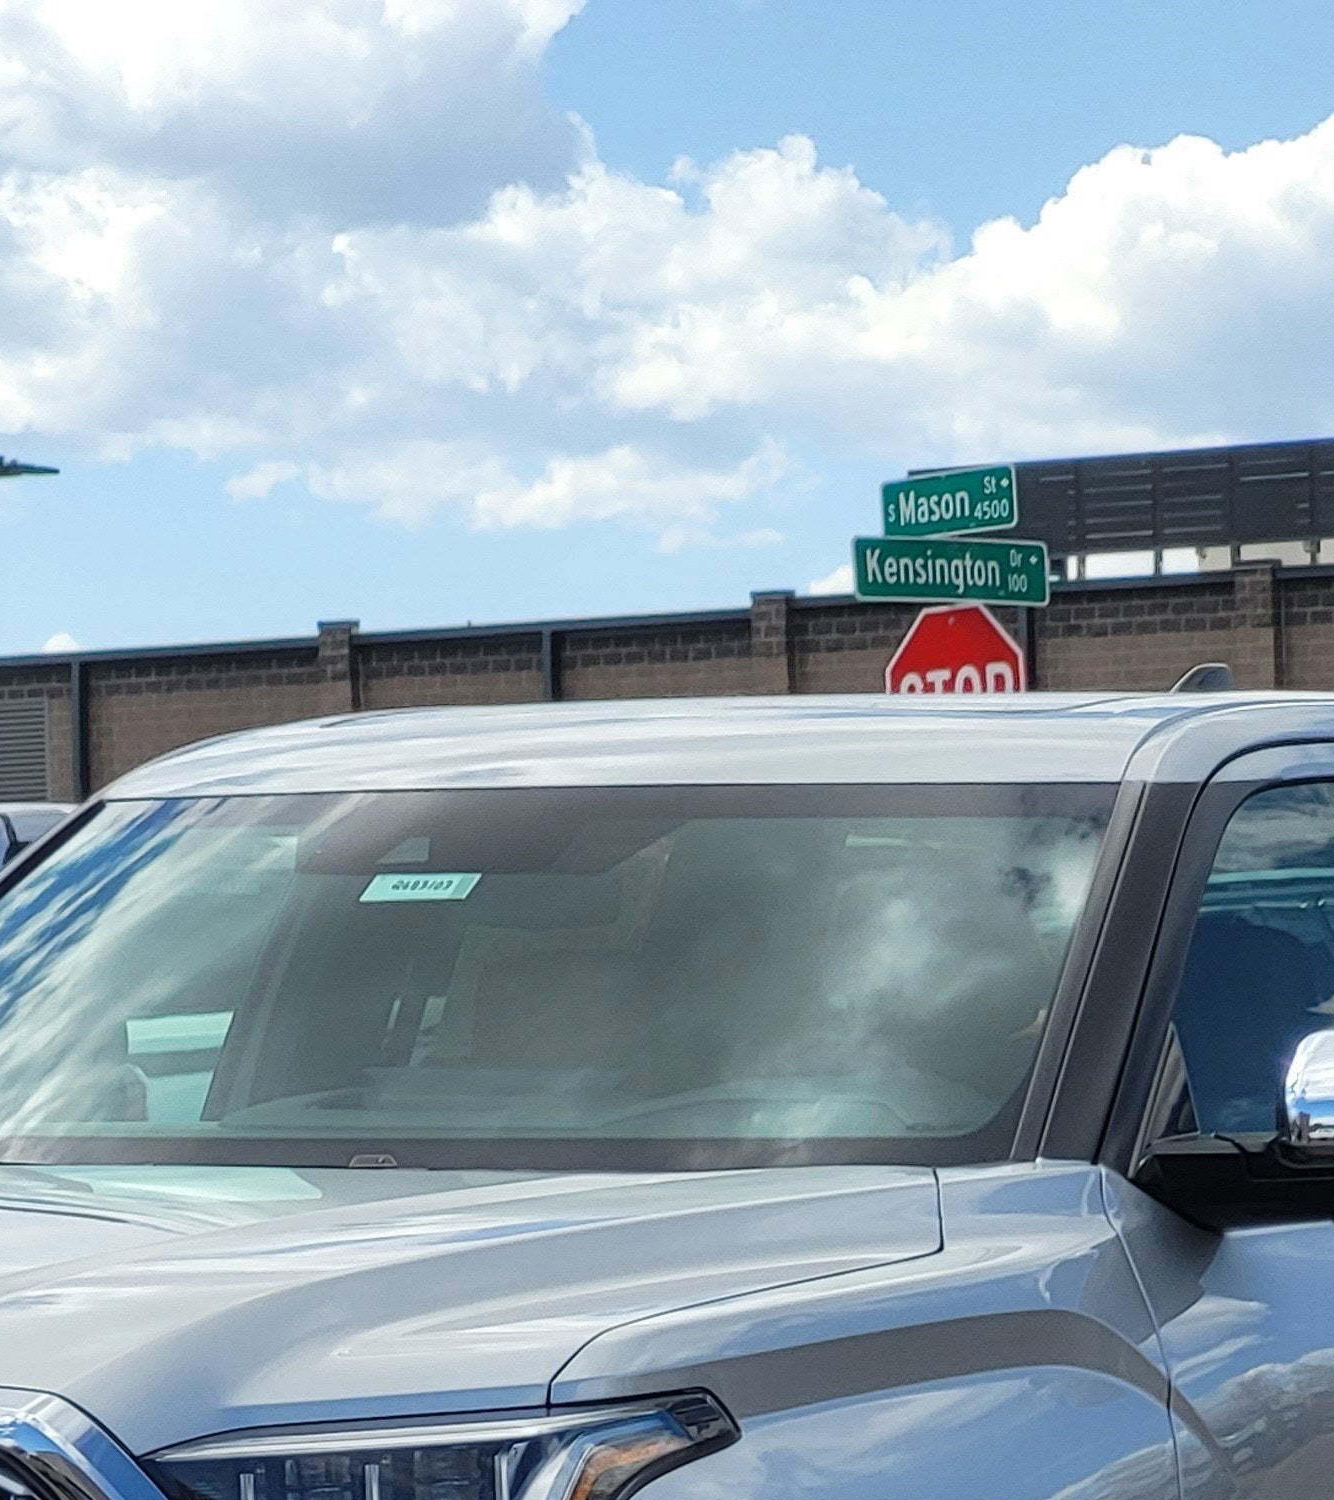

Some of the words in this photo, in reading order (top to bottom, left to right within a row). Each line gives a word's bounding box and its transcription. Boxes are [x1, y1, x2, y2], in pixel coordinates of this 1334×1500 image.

[887, 502, 896, 523] S
[898, 489, 970, 526] Mason
[983, 475, 997, 494] St
[973, 498, 1009, 520] 4500
[865, 547, 1001, 594] Kensington
[1009, 548, 1023, 567] Dr
[1007, 573, 1028, 593] 100
